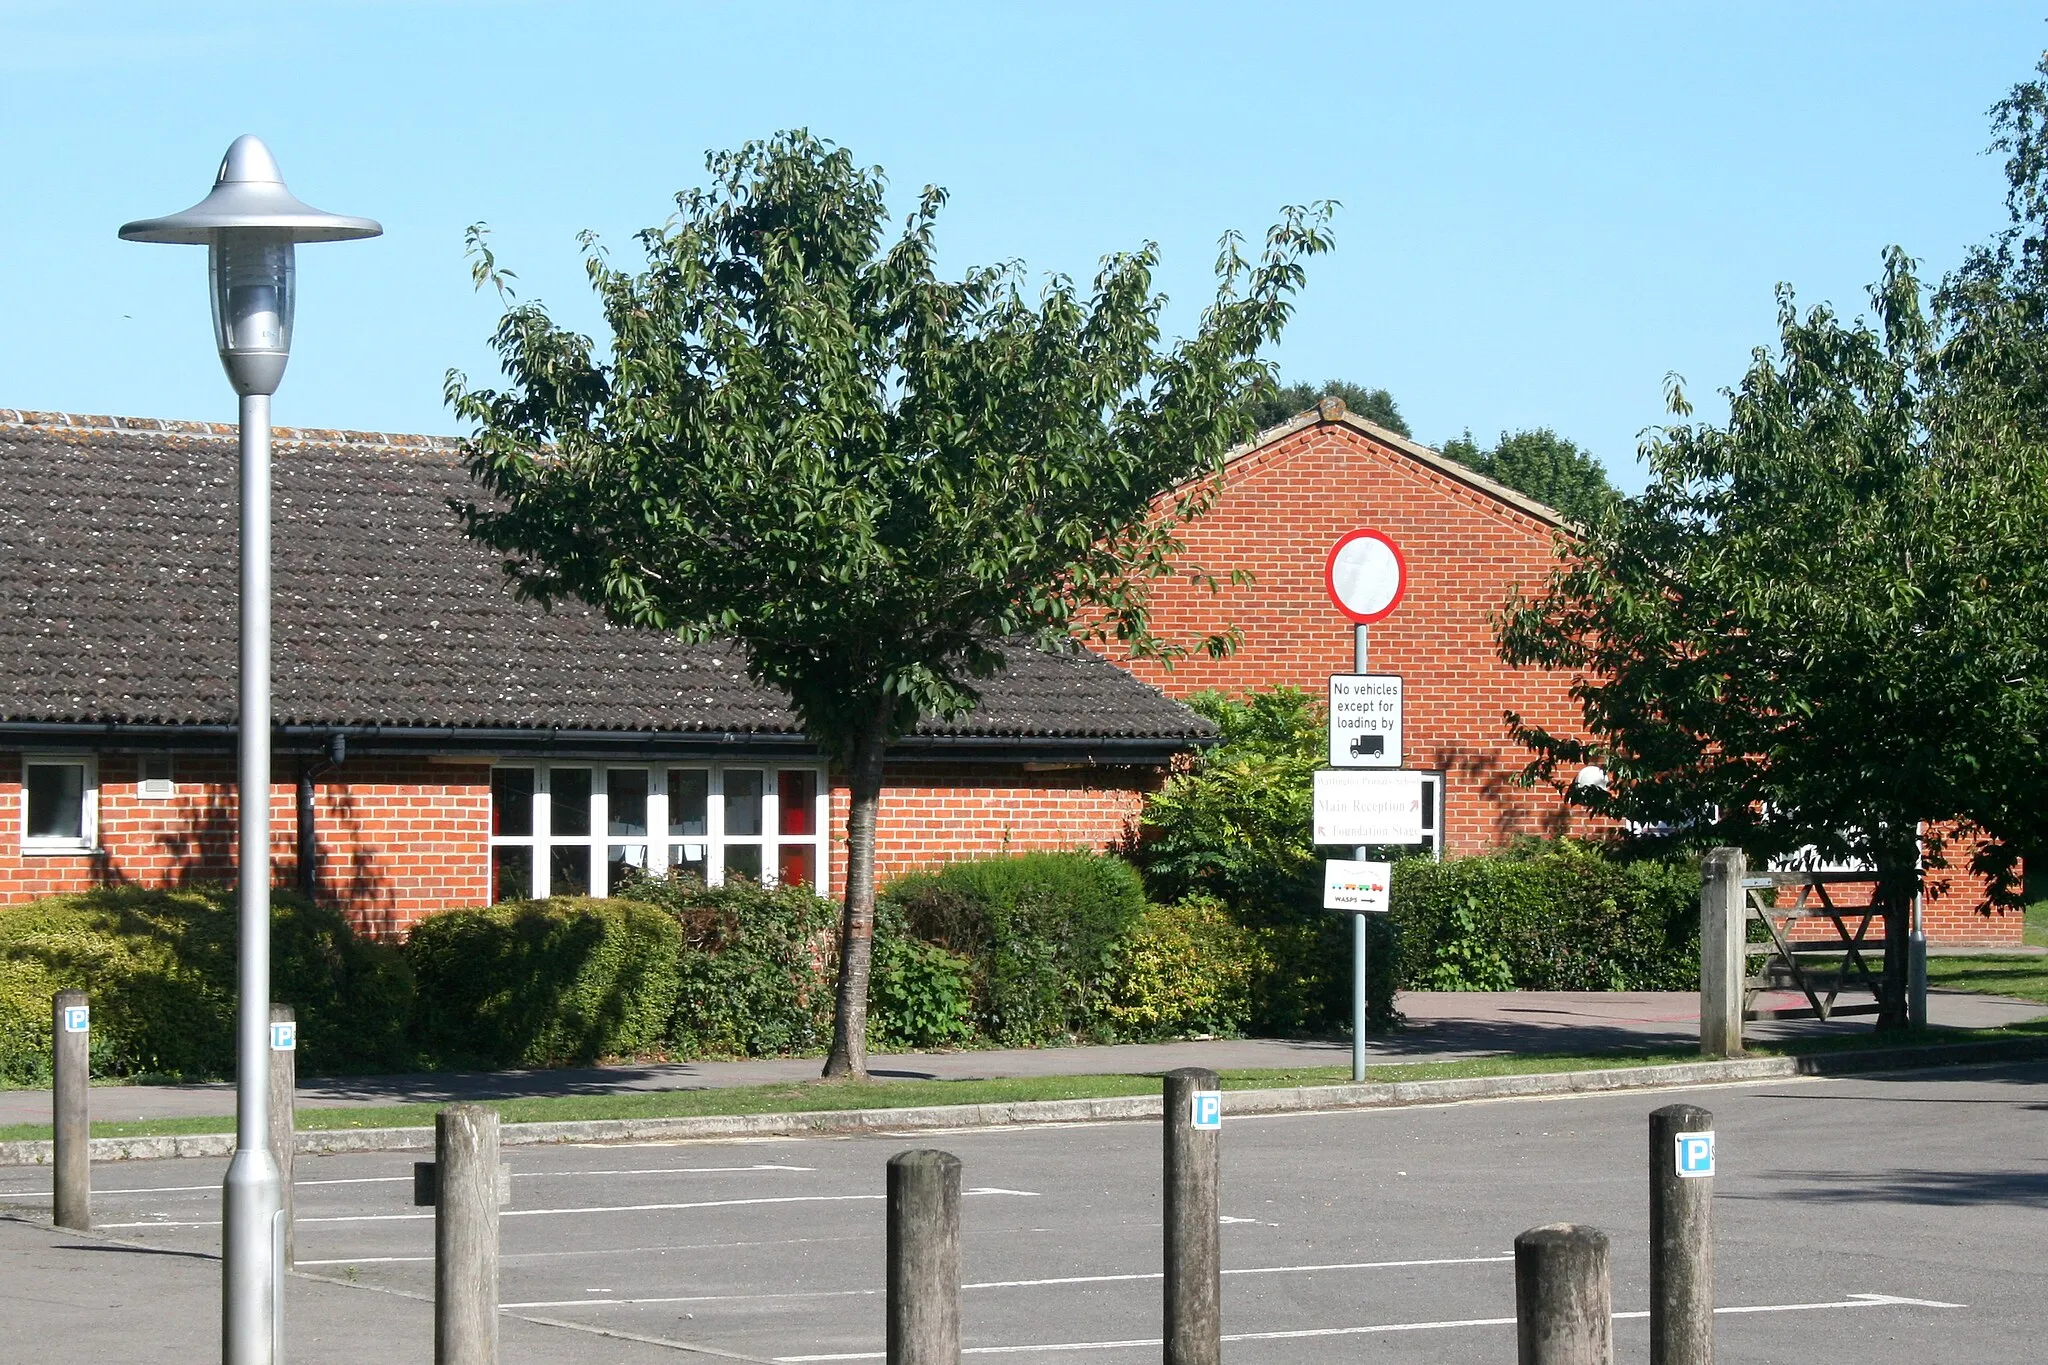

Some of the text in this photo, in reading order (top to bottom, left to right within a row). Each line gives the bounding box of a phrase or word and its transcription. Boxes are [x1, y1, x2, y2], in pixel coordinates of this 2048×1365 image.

[1334, 683, 1398, 695] No vehicles
[1337, 700, 1394, 713] except for
[1337, 717, 1394, 730] loading by
[1395, 776, 1420, 786] School
[1318, 799, 1405, 814] Main Reception
[1333, 824, 1420, 837] Foundation Stage
[72, 1010, 85, 1028] P
[278, 1027, 292, 1046] P
[1202, 1097, 1218, 1123] P
[1687, 1140, 1709, 1170] P
